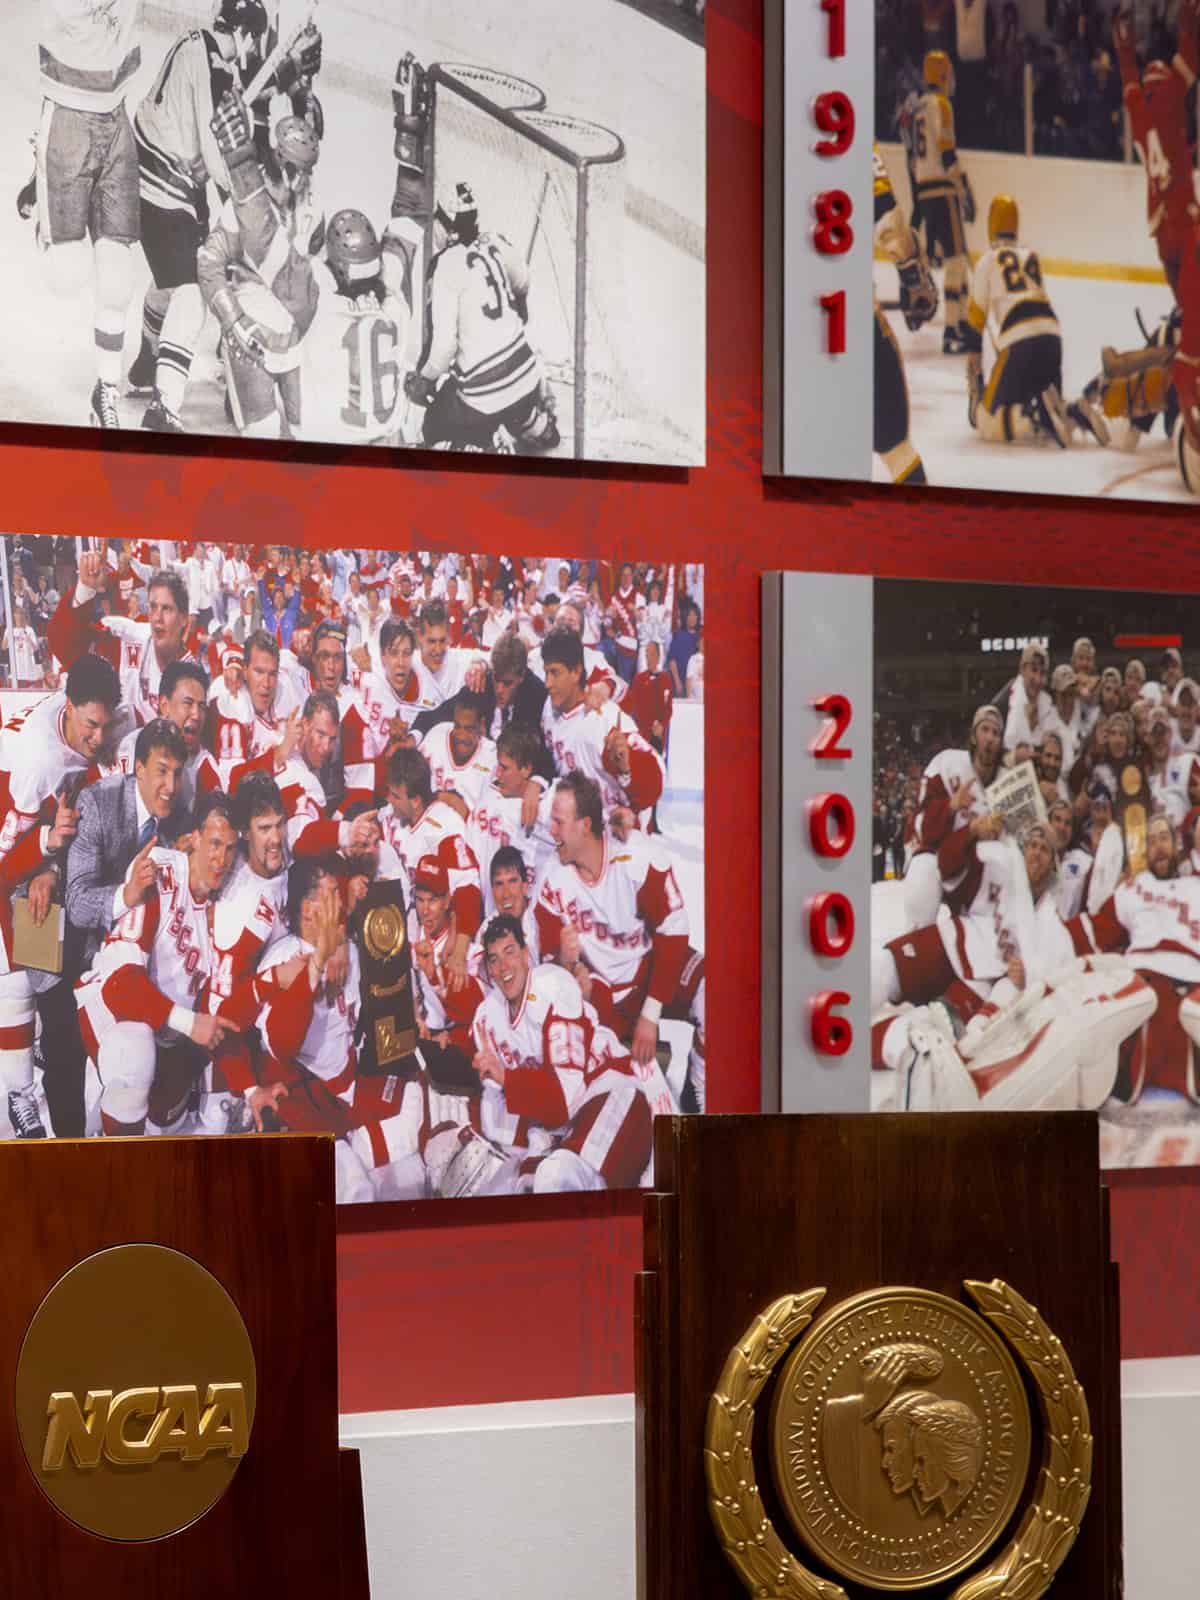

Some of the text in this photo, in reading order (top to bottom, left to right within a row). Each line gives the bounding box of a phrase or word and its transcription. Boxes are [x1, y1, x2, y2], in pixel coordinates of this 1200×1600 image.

[339, 317, 398, 428] 16
[808, 693, 856, 1057] 2006
[42, 1382, 250, 1472] NCAA
[793, 1306, 893, 1403] COLLEGIATE
[903, 1304, 989, 1358] ATHLETIC
[969, 1369, 1015, 1528] ASSOCIATION
